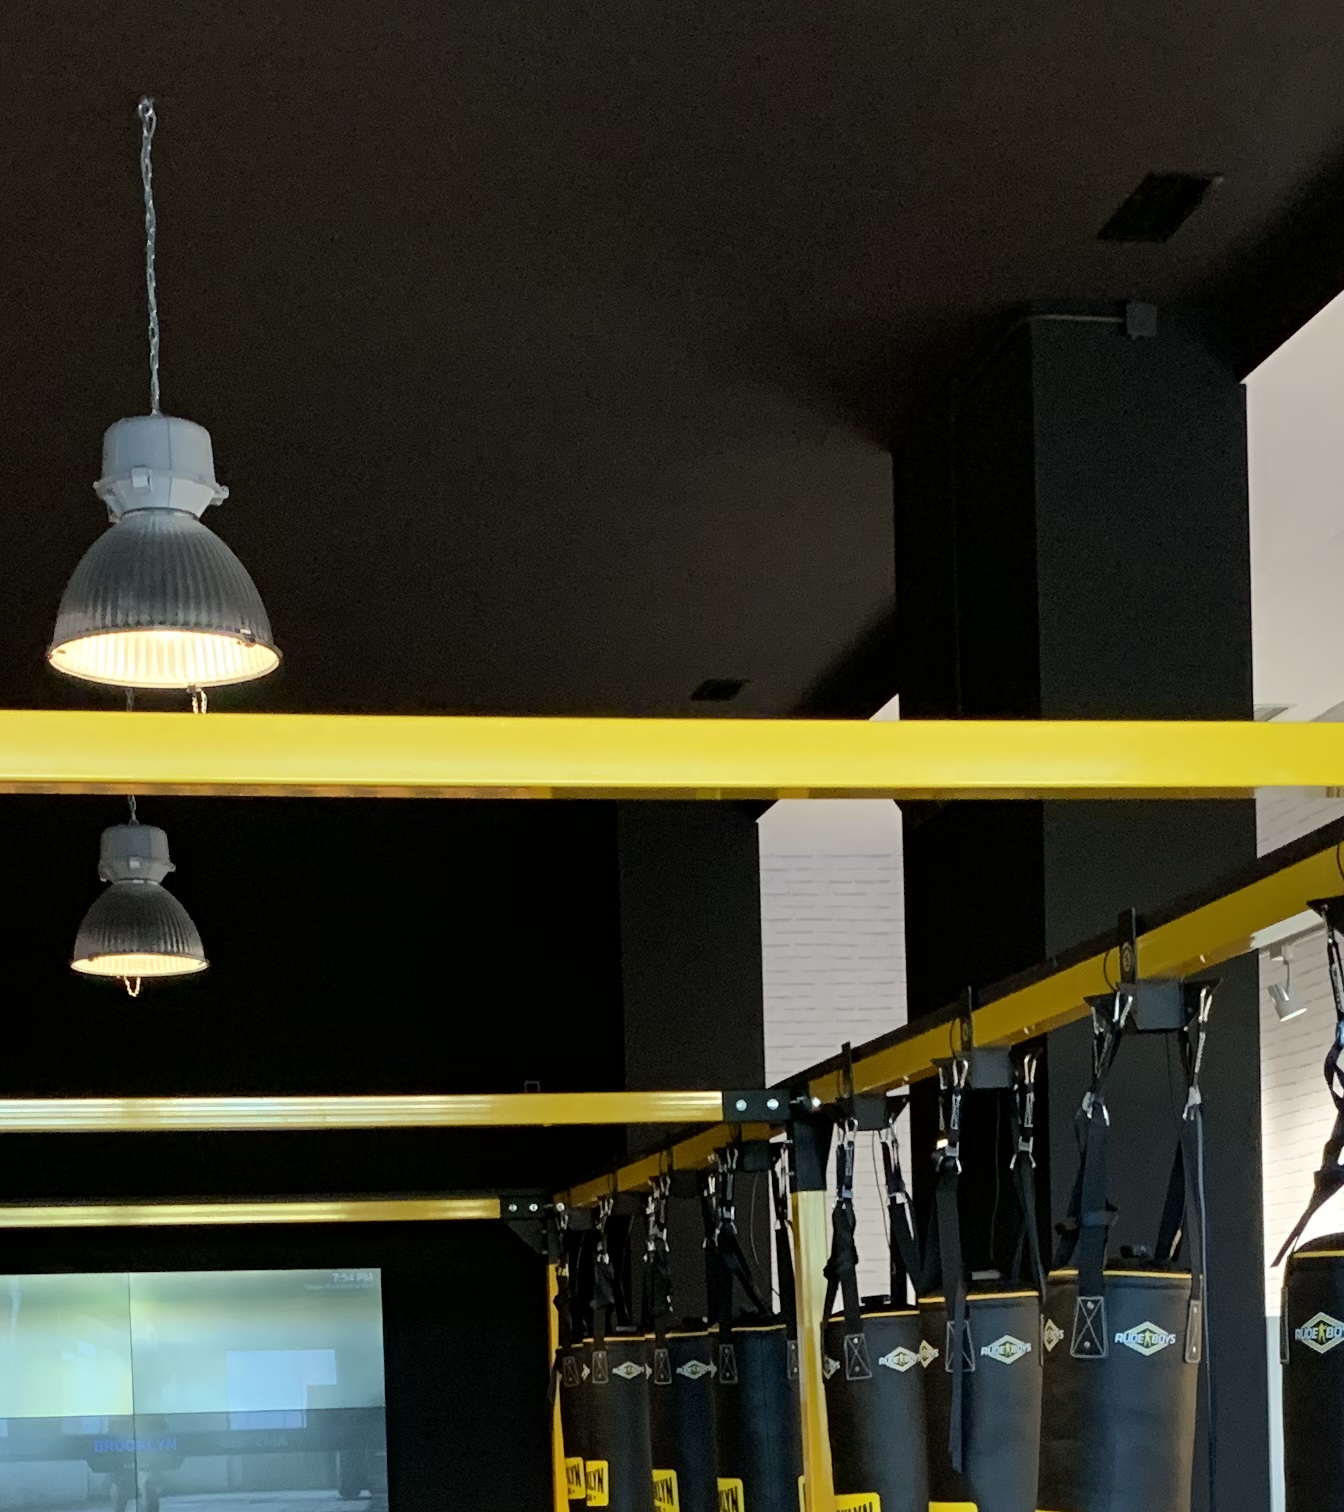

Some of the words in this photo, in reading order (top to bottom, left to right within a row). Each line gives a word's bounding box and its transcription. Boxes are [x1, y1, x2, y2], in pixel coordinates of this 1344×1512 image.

[1115, 1333, 1144, 1344] RUDE
[1152, 1333, 1176, 1344] BOYS
[1295, 1328, 1318, 1340] RUDE
